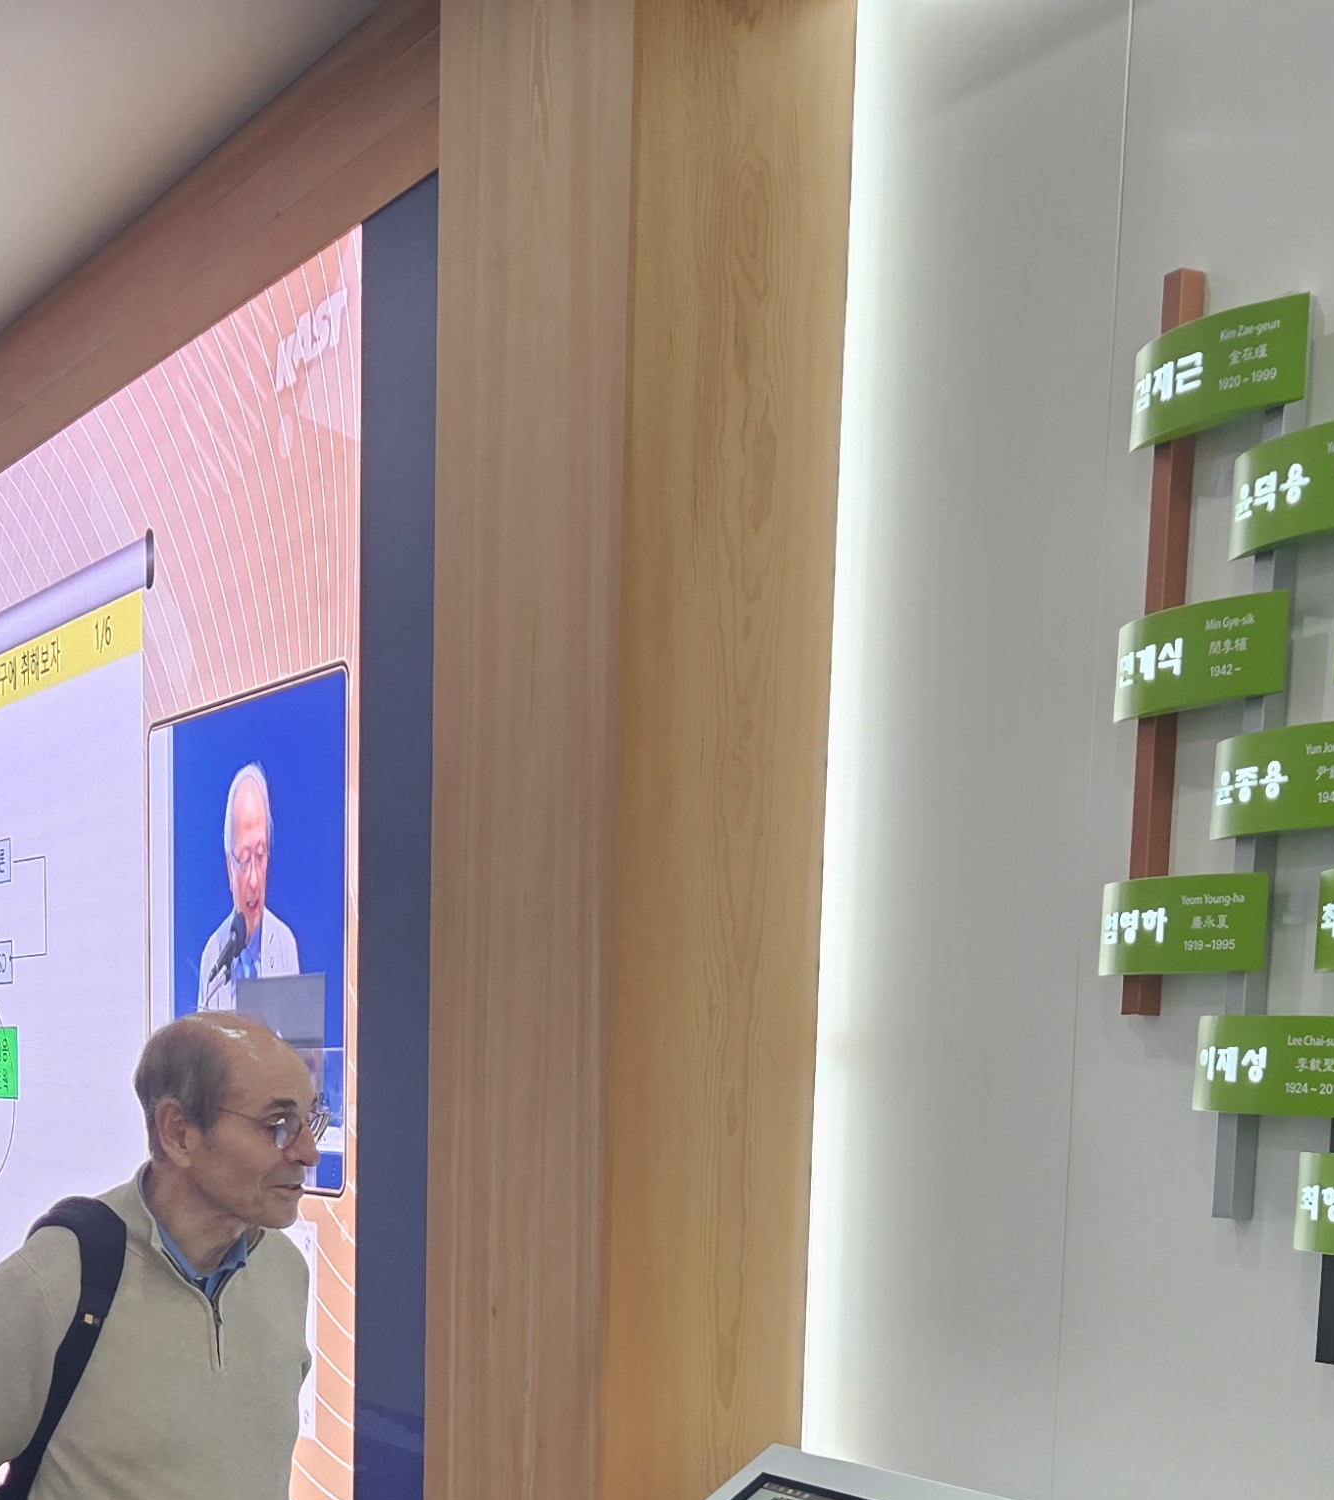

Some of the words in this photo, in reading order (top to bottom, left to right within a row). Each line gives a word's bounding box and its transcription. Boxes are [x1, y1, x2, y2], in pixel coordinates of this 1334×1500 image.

[1220, 329, 1236, 342] Kim
[1238, 319, 1280, 338] Zae-geun
[1136, 352, 1203, 414] 김재근
[1218, 375, 1241, 391] 1920
[1251, 367, 1277, 383] 1999
[1234, 463, 1310, 523] 윤덕용
[94, 615, 112, 653] 1/6
[1205, 618, 1220, 630] Min
[1221, 614, 1255, 629] Gye-sik
[20, 637, 60, 688] 취해보자
[1119, 637, 1183, 688] 민계식
[1209, 664, 1232, 677] 1942
[1305, 743, 1321, 756] Yun
[1216, 760, 1288, 806] 윤종용
[1181, 894, 1203, 905] Yeom
[1204, 892, 1245, 906] Young-ha
[1103, 908, 1167, 944] 염영하
[1183, 939, 1203, 951] 1919
[1287, 1035, 1303, 1047] Lee
[1199, 1046, 1267, 1084] 이재성
[1285, 1082, 1308, 1095] 1924
